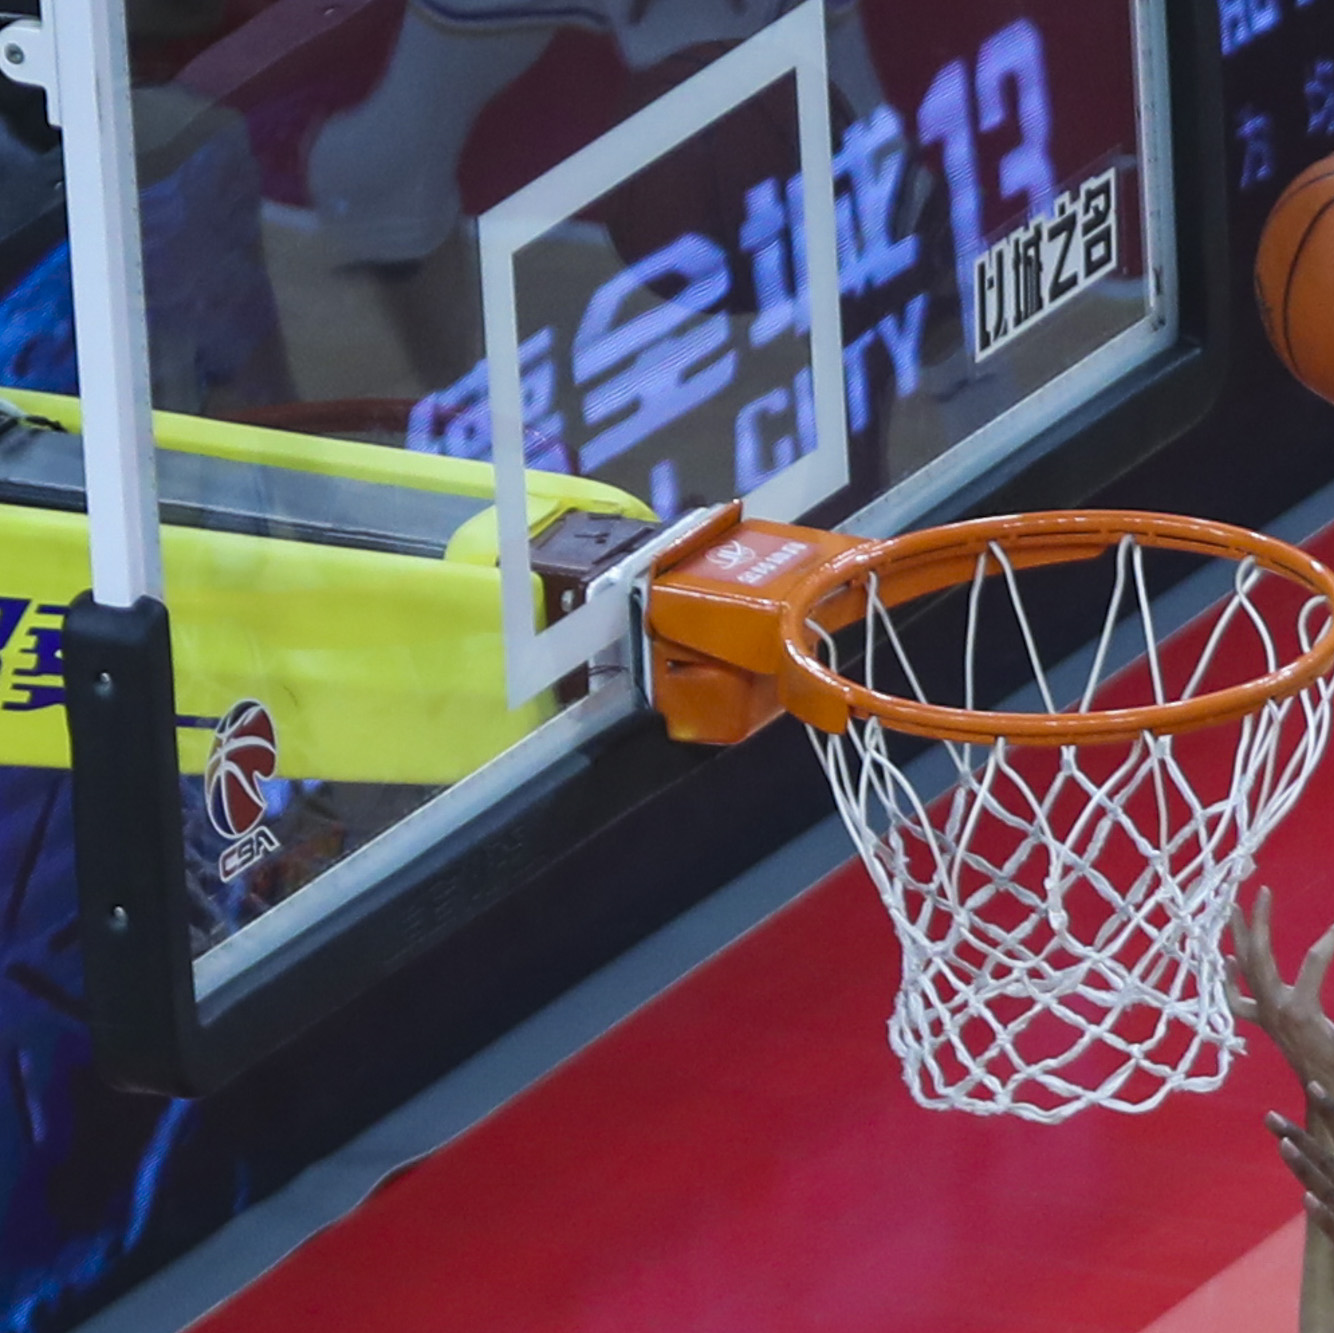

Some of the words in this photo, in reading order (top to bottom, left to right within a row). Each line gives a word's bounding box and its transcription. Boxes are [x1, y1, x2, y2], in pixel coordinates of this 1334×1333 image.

[976, 172, 1115, 357] 以城之名
[734, 293, 930, 497] CITY
[220, 827, 280, 881] CBA
